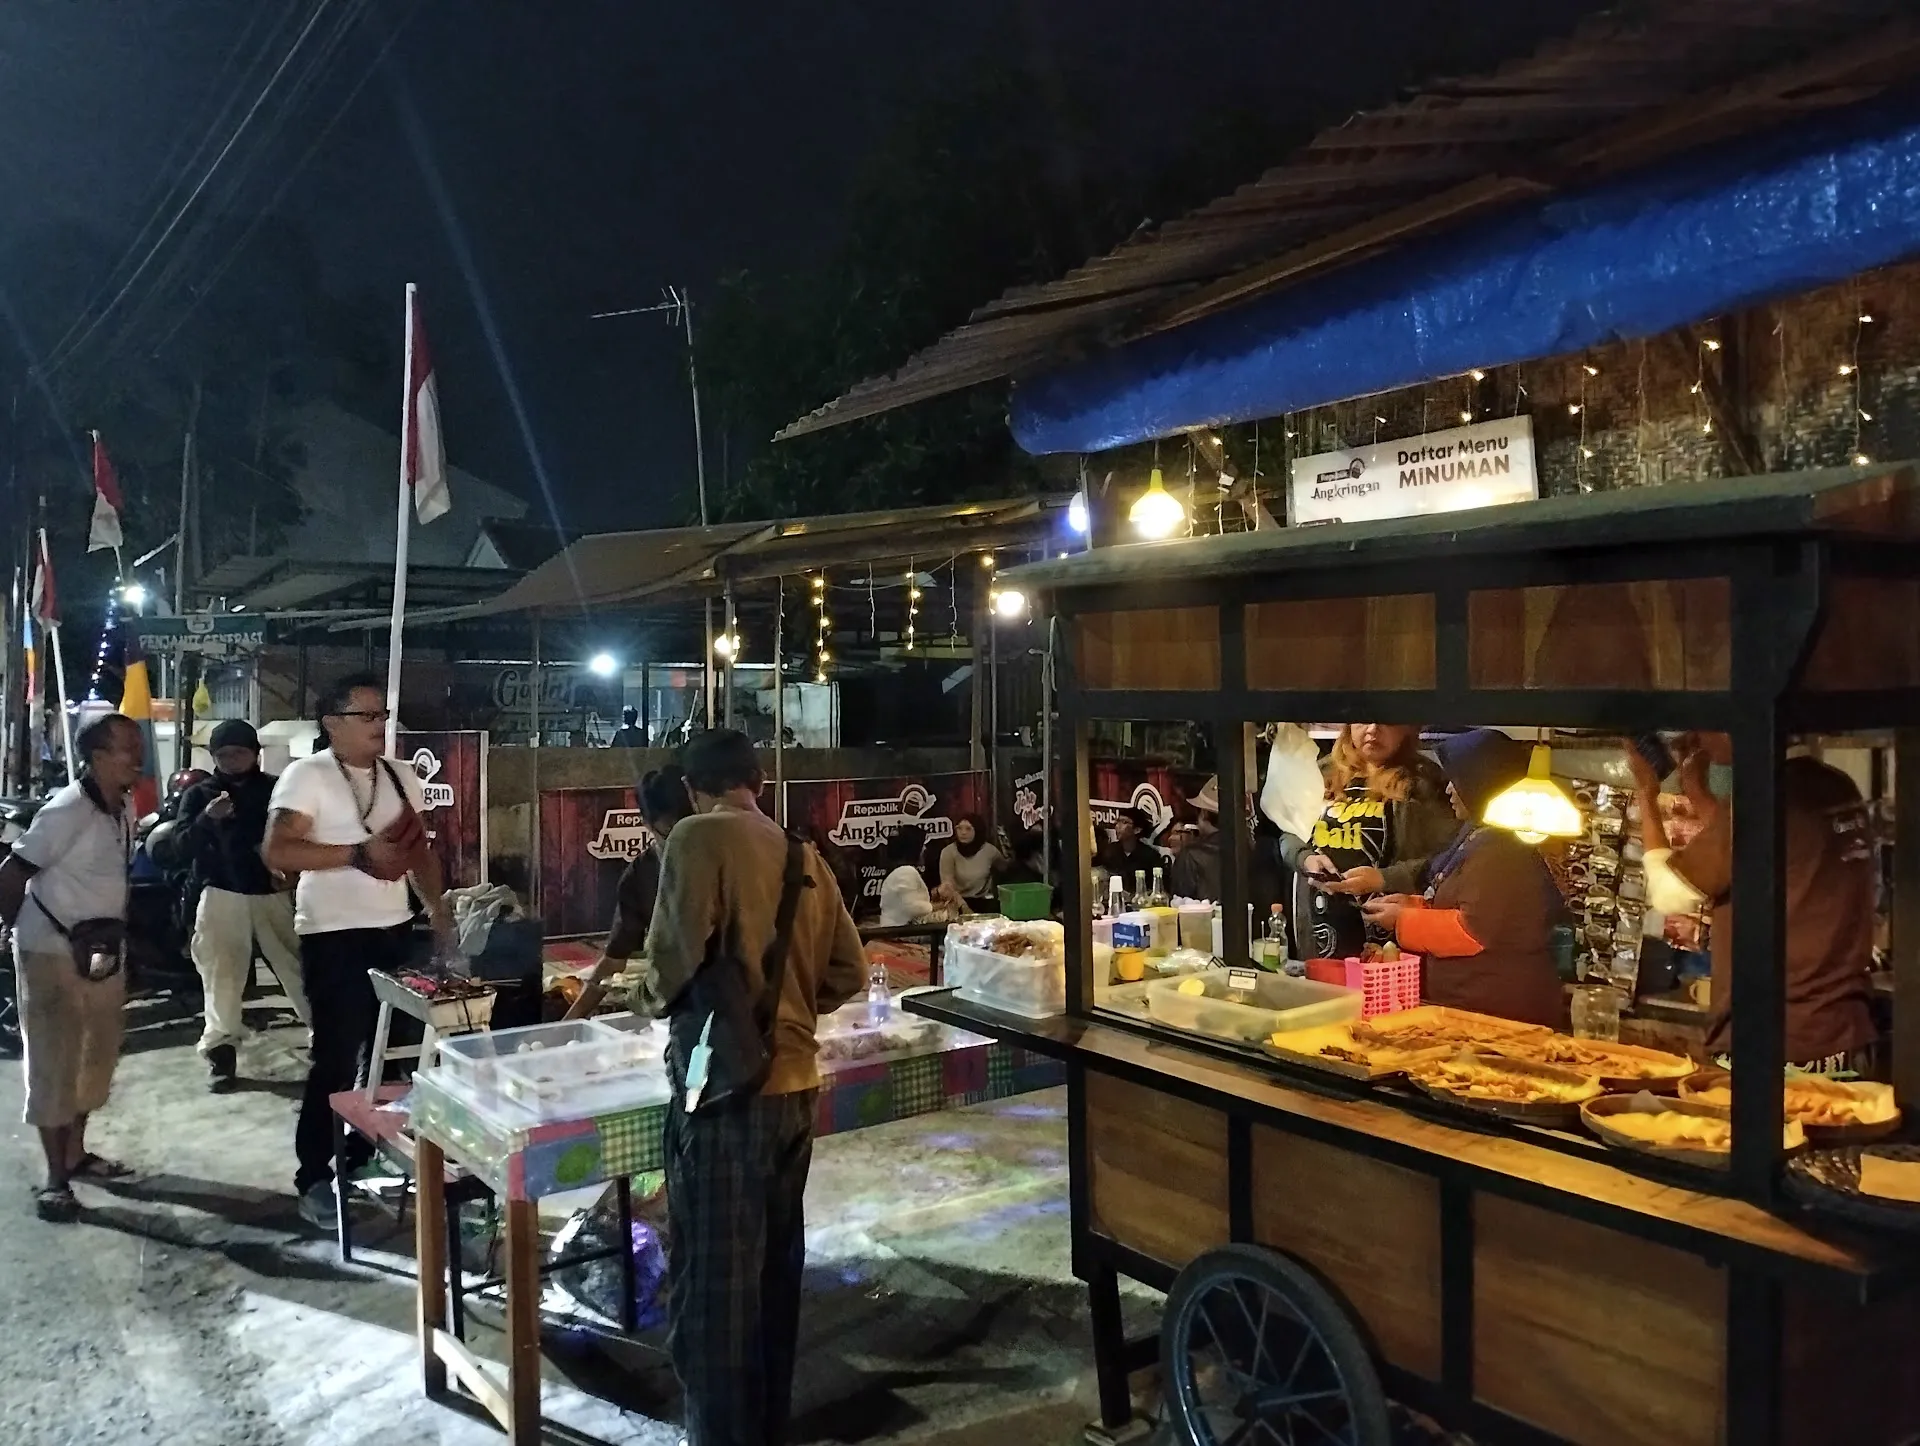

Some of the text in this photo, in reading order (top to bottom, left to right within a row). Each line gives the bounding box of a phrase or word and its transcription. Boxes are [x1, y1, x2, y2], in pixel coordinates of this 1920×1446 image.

[1397, 437, 1509, 465] Daftar Menu
[1399, 454, 1510, 488] MINUMAN
[1311, 481, 1380, 502] Angkringan
[422, 787, 450, 804] gan
[853, 804, 899, 817] Republik
